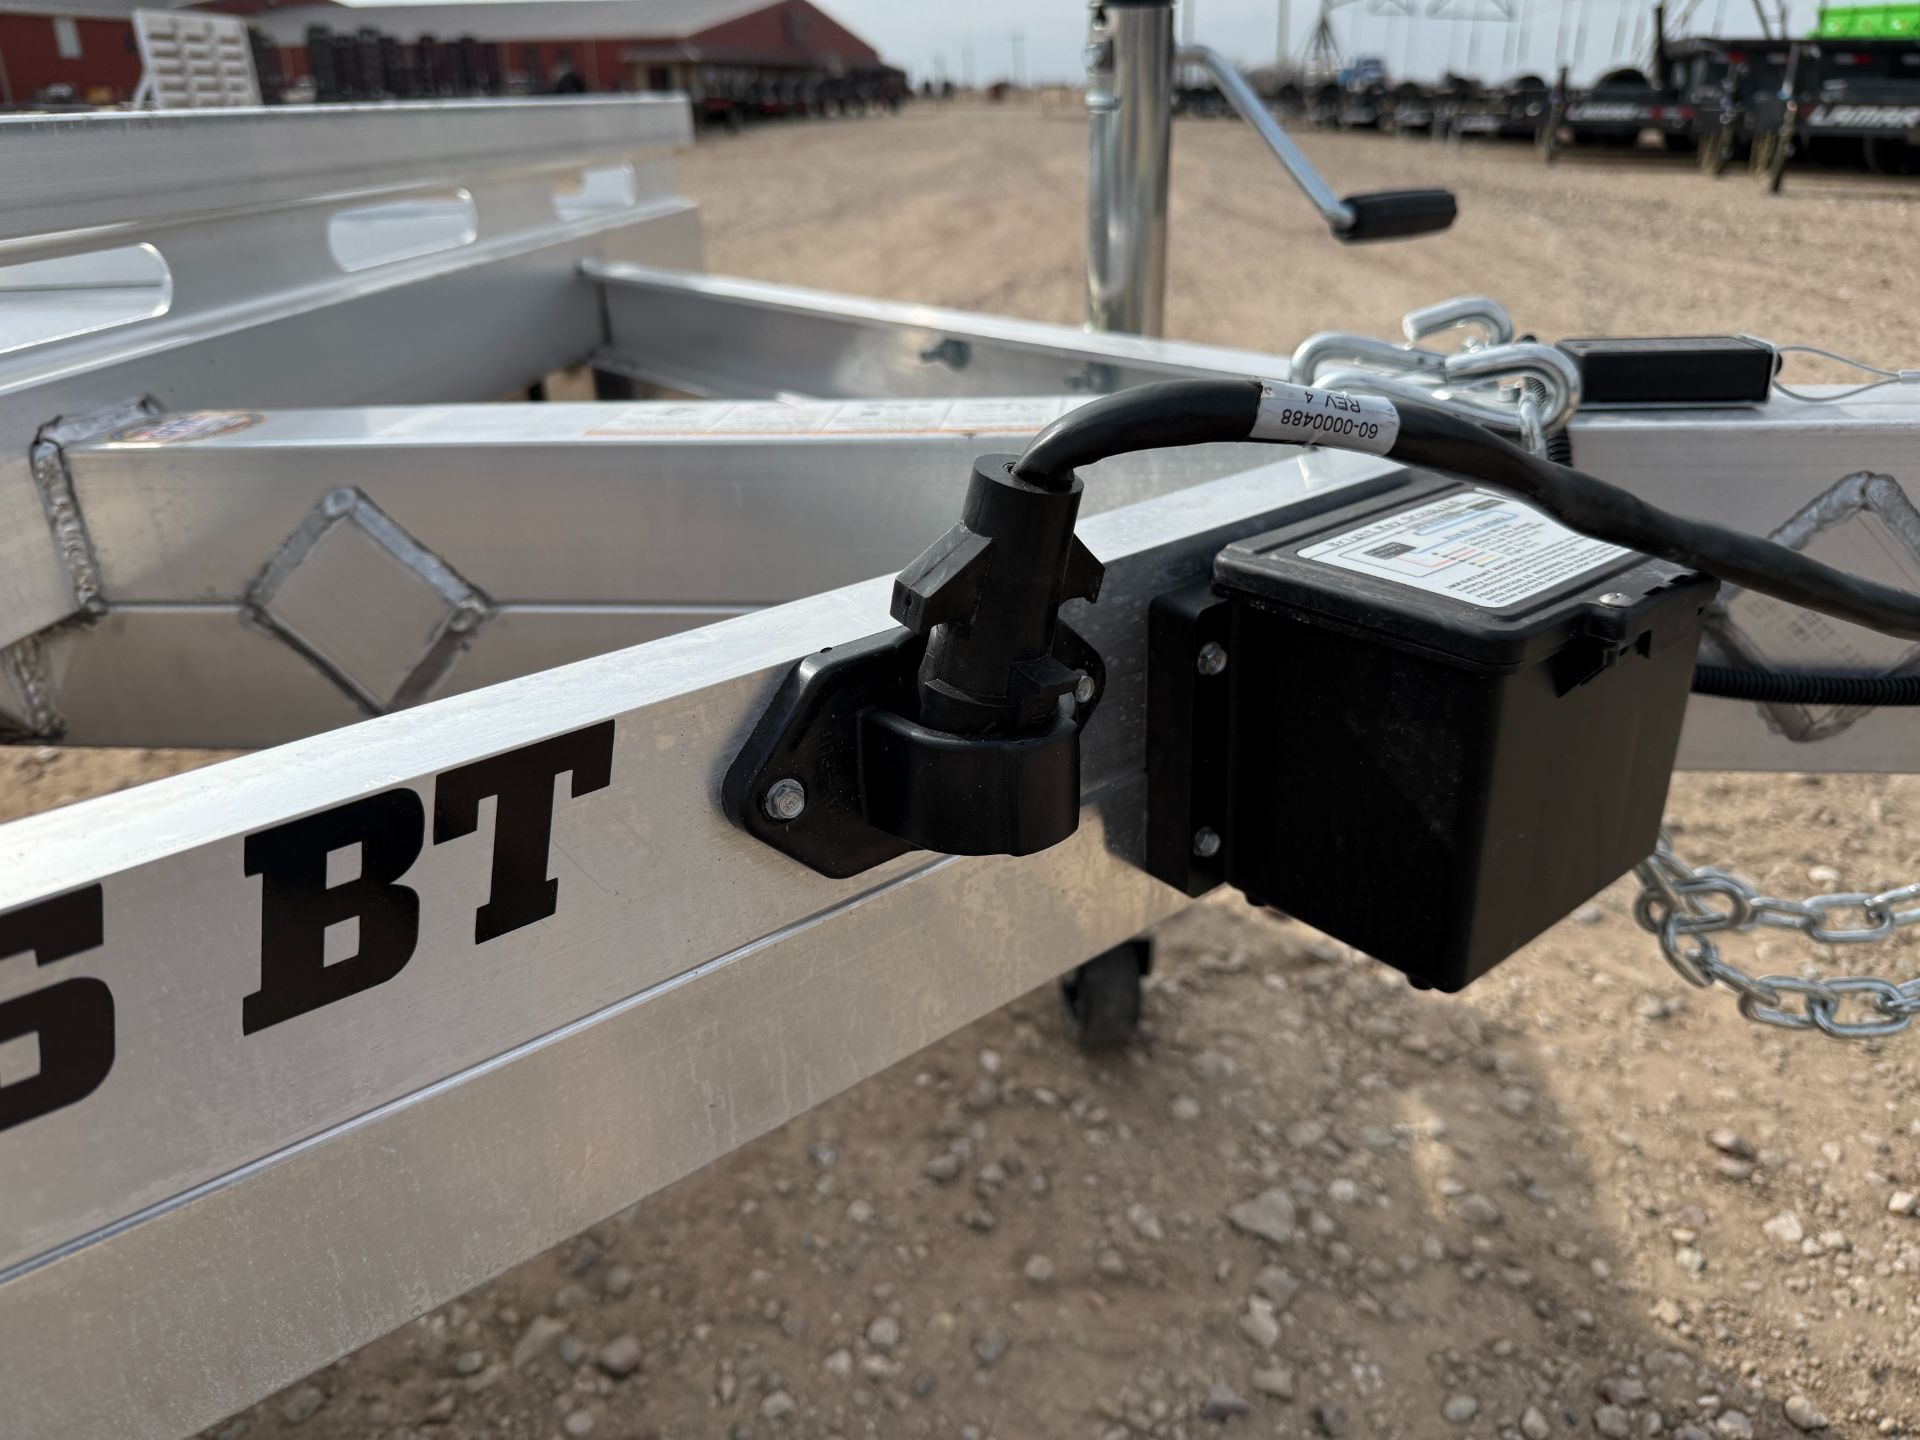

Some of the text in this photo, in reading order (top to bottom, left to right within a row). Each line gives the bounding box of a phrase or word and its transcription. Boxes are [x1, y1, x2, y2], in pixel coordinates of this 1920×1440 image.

[1303, 391, 1361, 413] REV 4
[1281, 409, 1378, 439] 60-0000488
[243, 719, 615, 1036] BT
